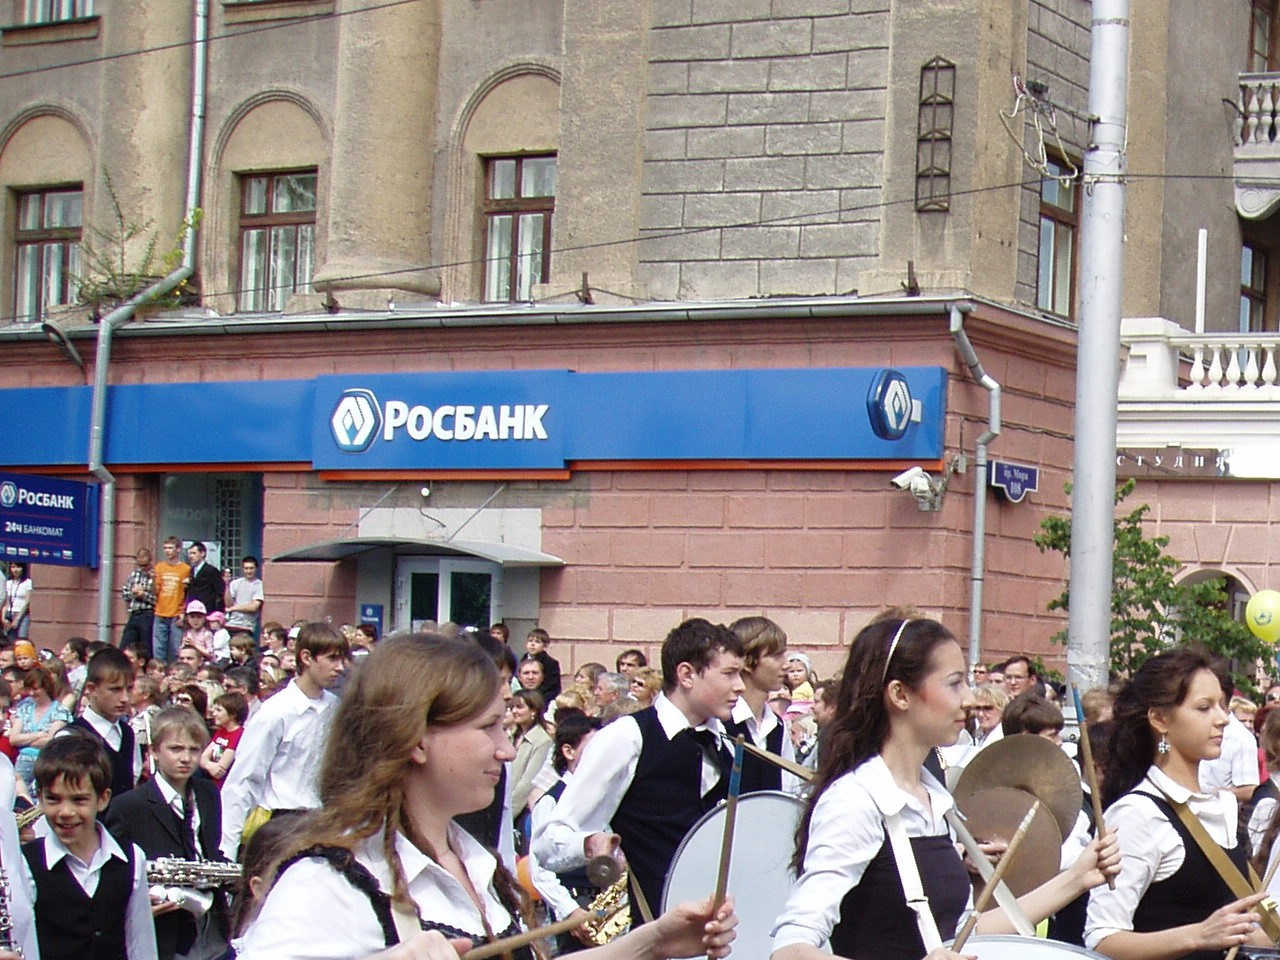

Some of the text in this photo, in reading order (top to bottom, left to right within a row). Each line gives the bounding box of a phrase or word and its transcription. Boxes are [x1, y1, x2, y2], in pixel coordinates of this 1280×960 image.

[383, 400, 549, 441] РОСБАНК
[1116, 455, 1225, 471] СТУДИЯ
[18, 488, 74, 509] РОСБАНК
[23, 524, 64, 537] БАНКОМАТ
